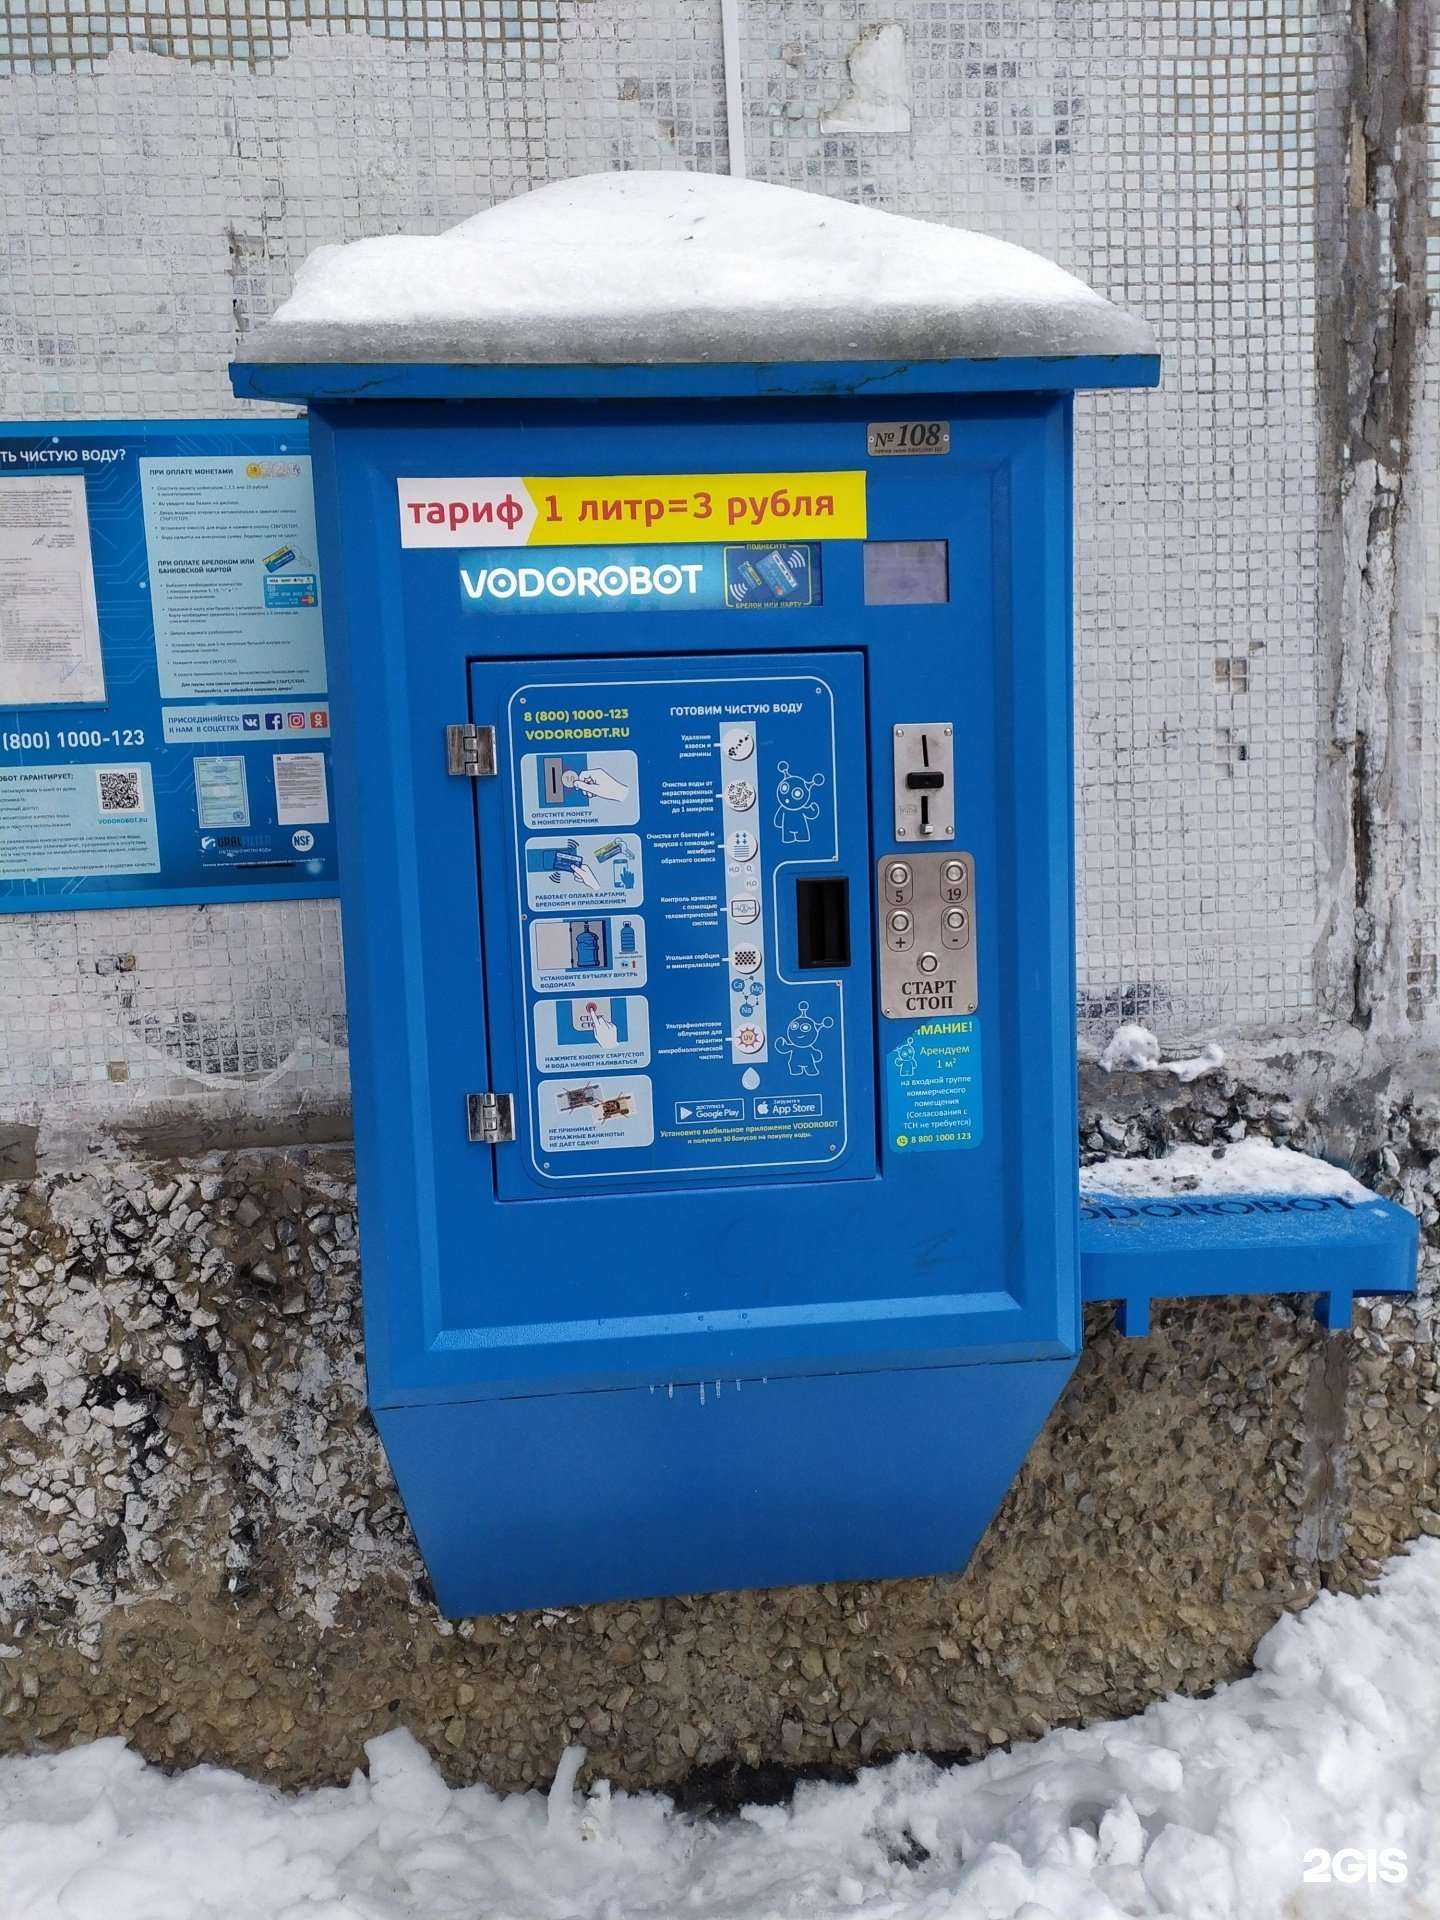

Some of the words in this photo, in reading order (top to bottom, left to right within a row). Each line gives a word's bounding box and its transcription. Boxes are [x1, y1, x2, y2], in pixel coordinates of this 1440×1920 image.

[897, 423, 941, 446] 108
[20, 450, 78, 462] ЧИСТУЮ
[82, 449, 126, 463] ВОДУ?
[407, 494, 524, 531] тариф
[545, 495, 562, 522] 1
[578, 490, 713, 527] литр=3
[727, 488, 834, 526] рубля
[158, 566, 204, 574] БАНКОВСКОЙ
[460, 564, 703, 599] VODOROBOT
[670, 706, 722, 716] ГОТОВИМ
[725, 704, 769, 715] ЧИСТУЮ
[773, 703, 803, 714] ВОДУ
[168, 715, 240, 724] ПРИСОЕДИНЯЙТЕСЬ
[524, 712, 532, 722] 8
[535, 710, 570, 724] (800)
[572, 708, 629, 720] 1000-123
[203, 724, 240, 733] СОЦСЕТЯХ
[525, 727, 630, 740] VODOROBOT.RU
[3, 731, 50, 751] (800)
[57, 730, 145, 748] 1000-123
[20, 773, 74, 781] ГАРАНТИРУЕТ:
[294, 835, 310, 846] NSF
[895, 890, 904, 903] 5
[947, 888, 961, 901] 19
[734, 981, 743, 989] Ca
[902, 980, 957, 996] СТАРТ
[906, 996, 953, 1011] СТОП
[606, 1052, 645, 1060] СТАРТ/СТОП
[920, 1045, 970, 1056] Арендуем
[596, 1059, 638, 1067] НАЛИВАТЬСЯ
[936, 1060, 942, 1069] 1
[911, 1076, 944, 1086] входной
[907, 1088, 966, 1096] коммерческого
[914, 1099, 959, 1107] помещения
[696, 1110, 723, 1119] Google
[724, 1108, 740, 1118] Play
[772, 1105, 792, 1115] App
[792, 1104, 816, 1113] Store
[745, 1124, 792, 1133] приложение
[793, 1120, 839, 1129] VODOROBOT
[931, 1119, 971, 1129] требуется)
[911, 1136, 916, 1144] 8
[918, 1135, 933, 1143] 800
[935, 1134, 954, 1142] 1000
[957, 1132, 971, 1140] 123
